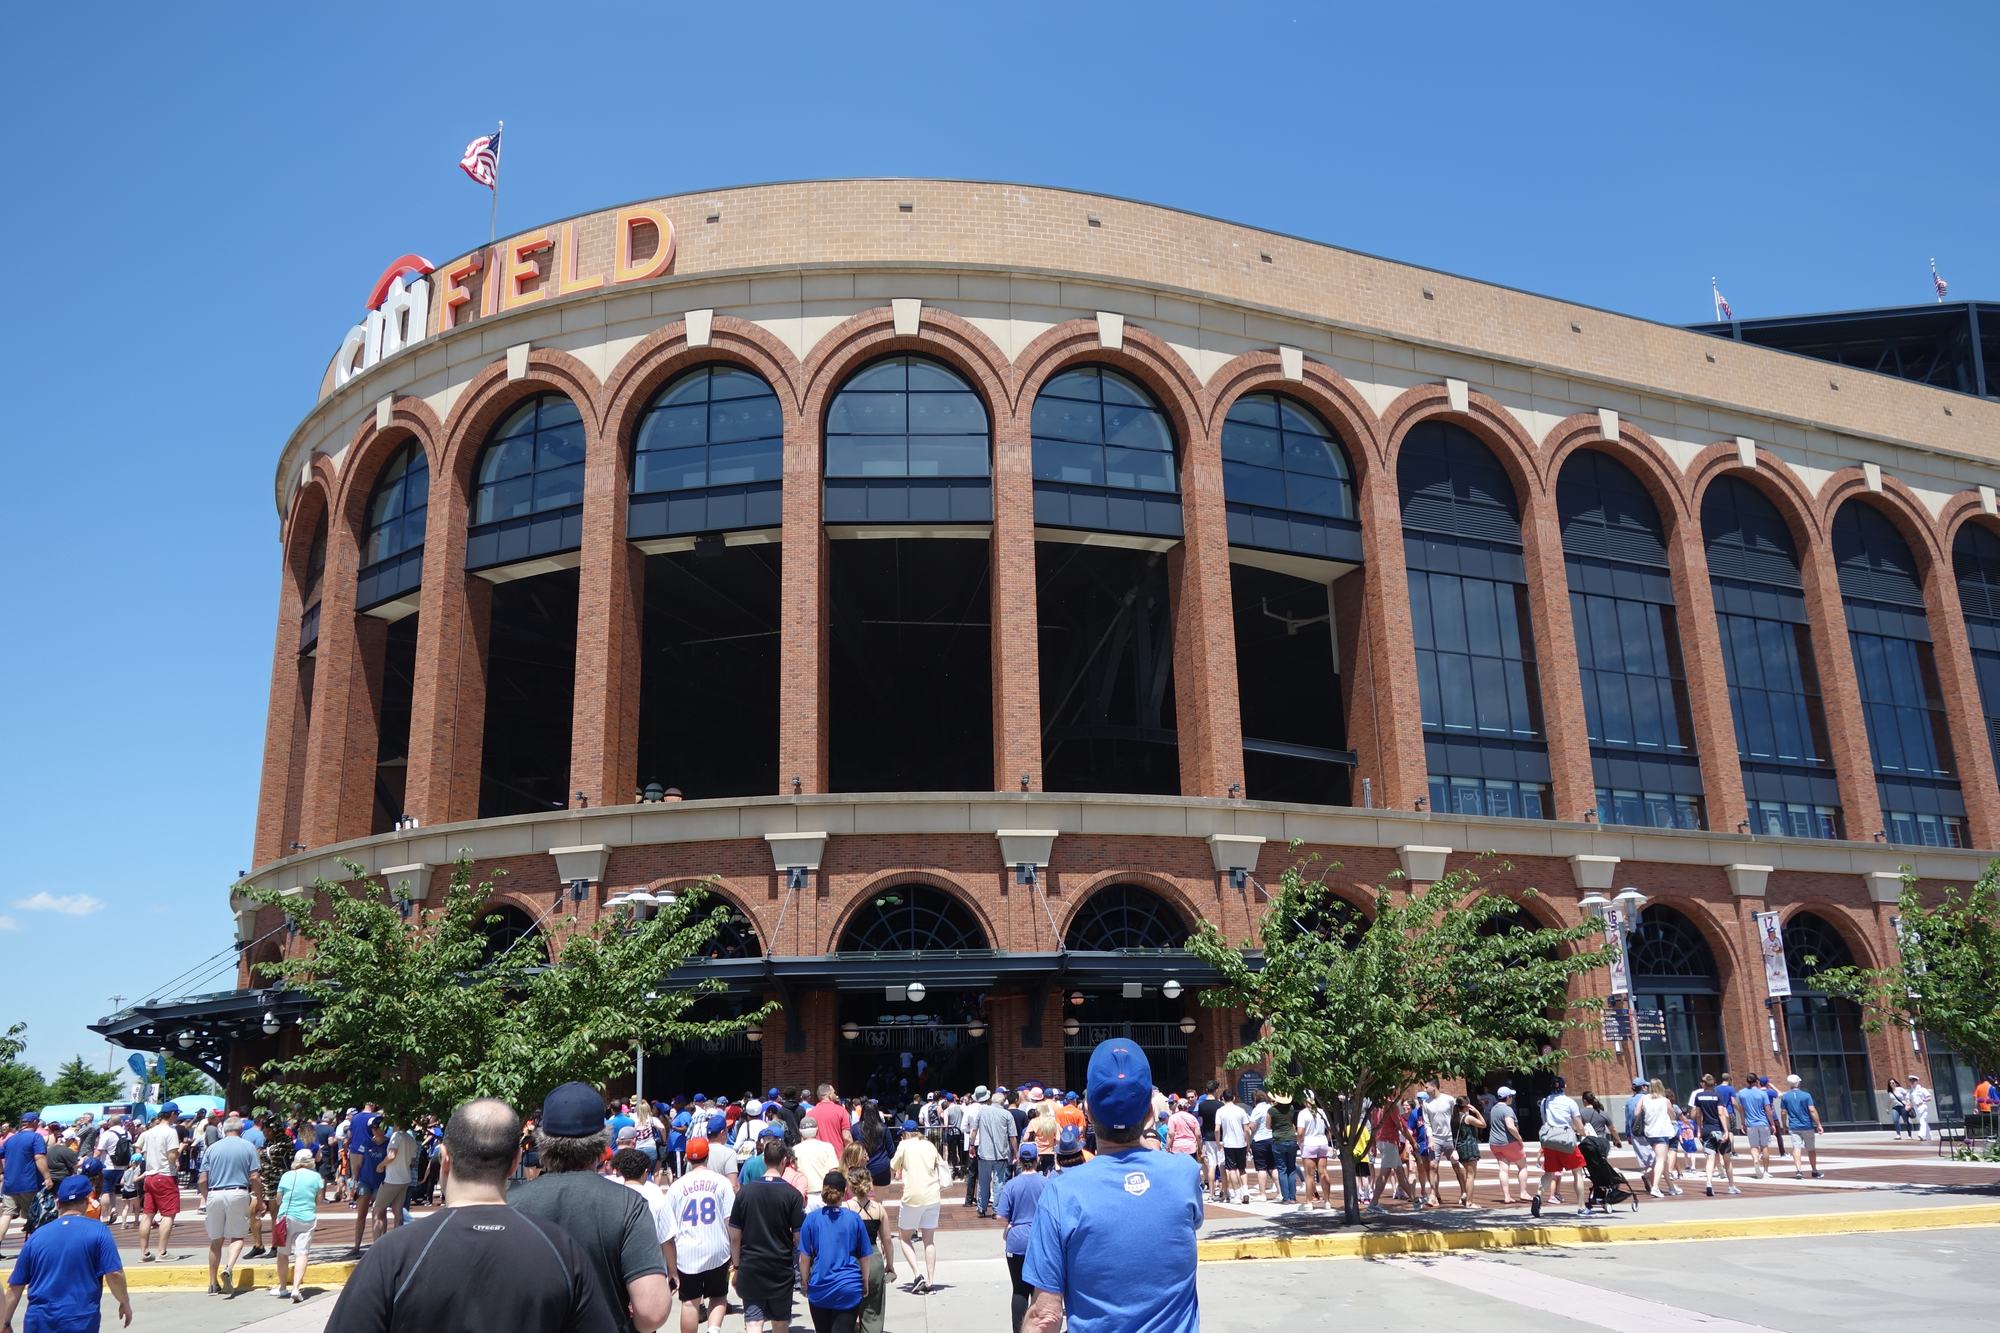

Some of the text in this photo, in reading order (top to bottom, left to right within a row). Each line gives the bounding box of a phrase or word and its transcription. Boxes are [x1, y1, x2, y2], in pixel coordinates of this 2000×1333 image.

[438, 206, 676, 333] FIELD
[1607, 910, 1617, 923] 16
[1764, 916, 1773, 928] 17
[683, 1180, 718, 1197] deGROM
[682, 1197, 716, 1227] 48
